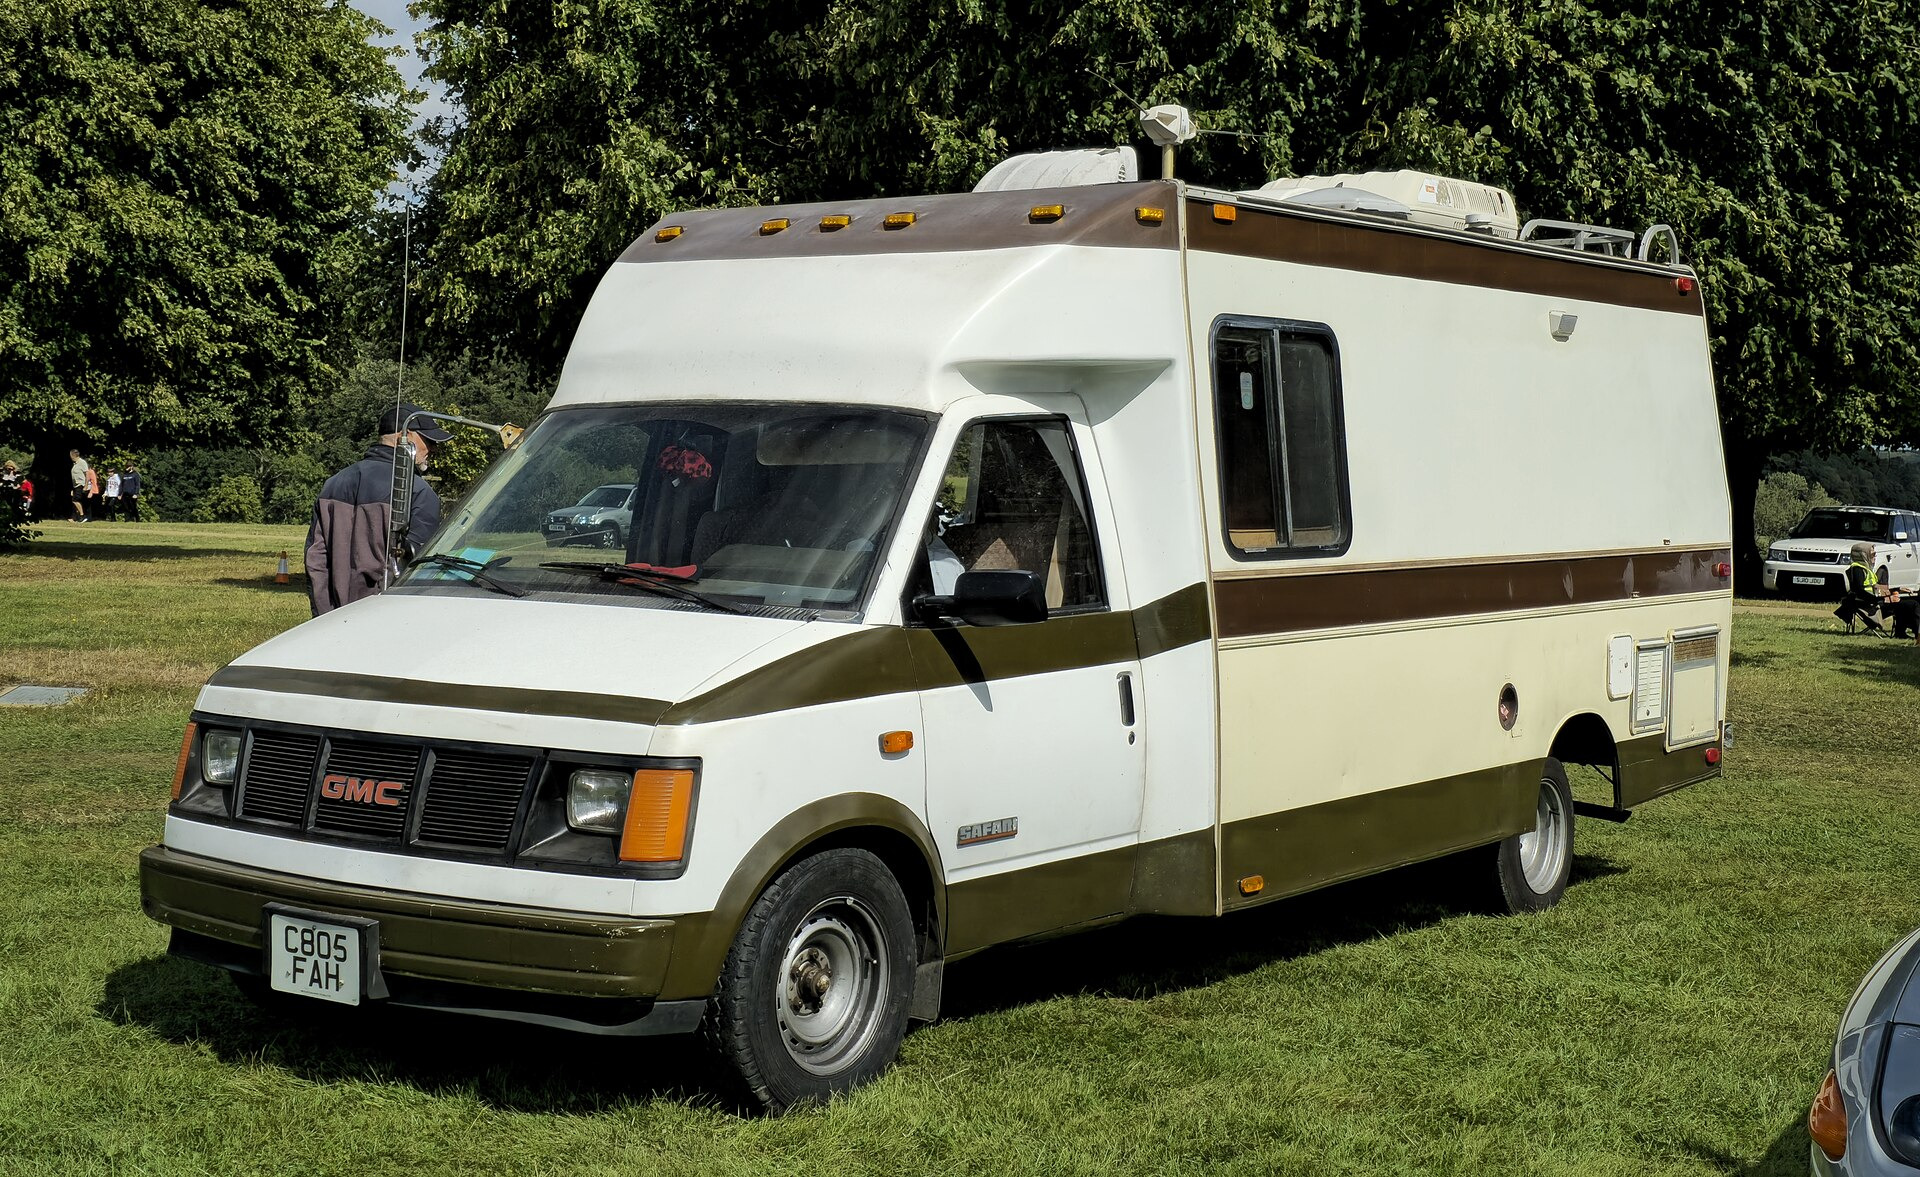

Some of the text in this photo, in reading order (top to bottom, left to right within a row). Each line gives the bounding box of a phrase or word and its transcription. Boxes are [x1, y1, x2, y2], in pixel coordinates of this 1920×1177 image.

[322, 774, 404, 806] GMC
[959, 817, 1018, 840] SAFARI
[285, 925, 347, 962] C805
[292, 956, 340, 992] FAH
